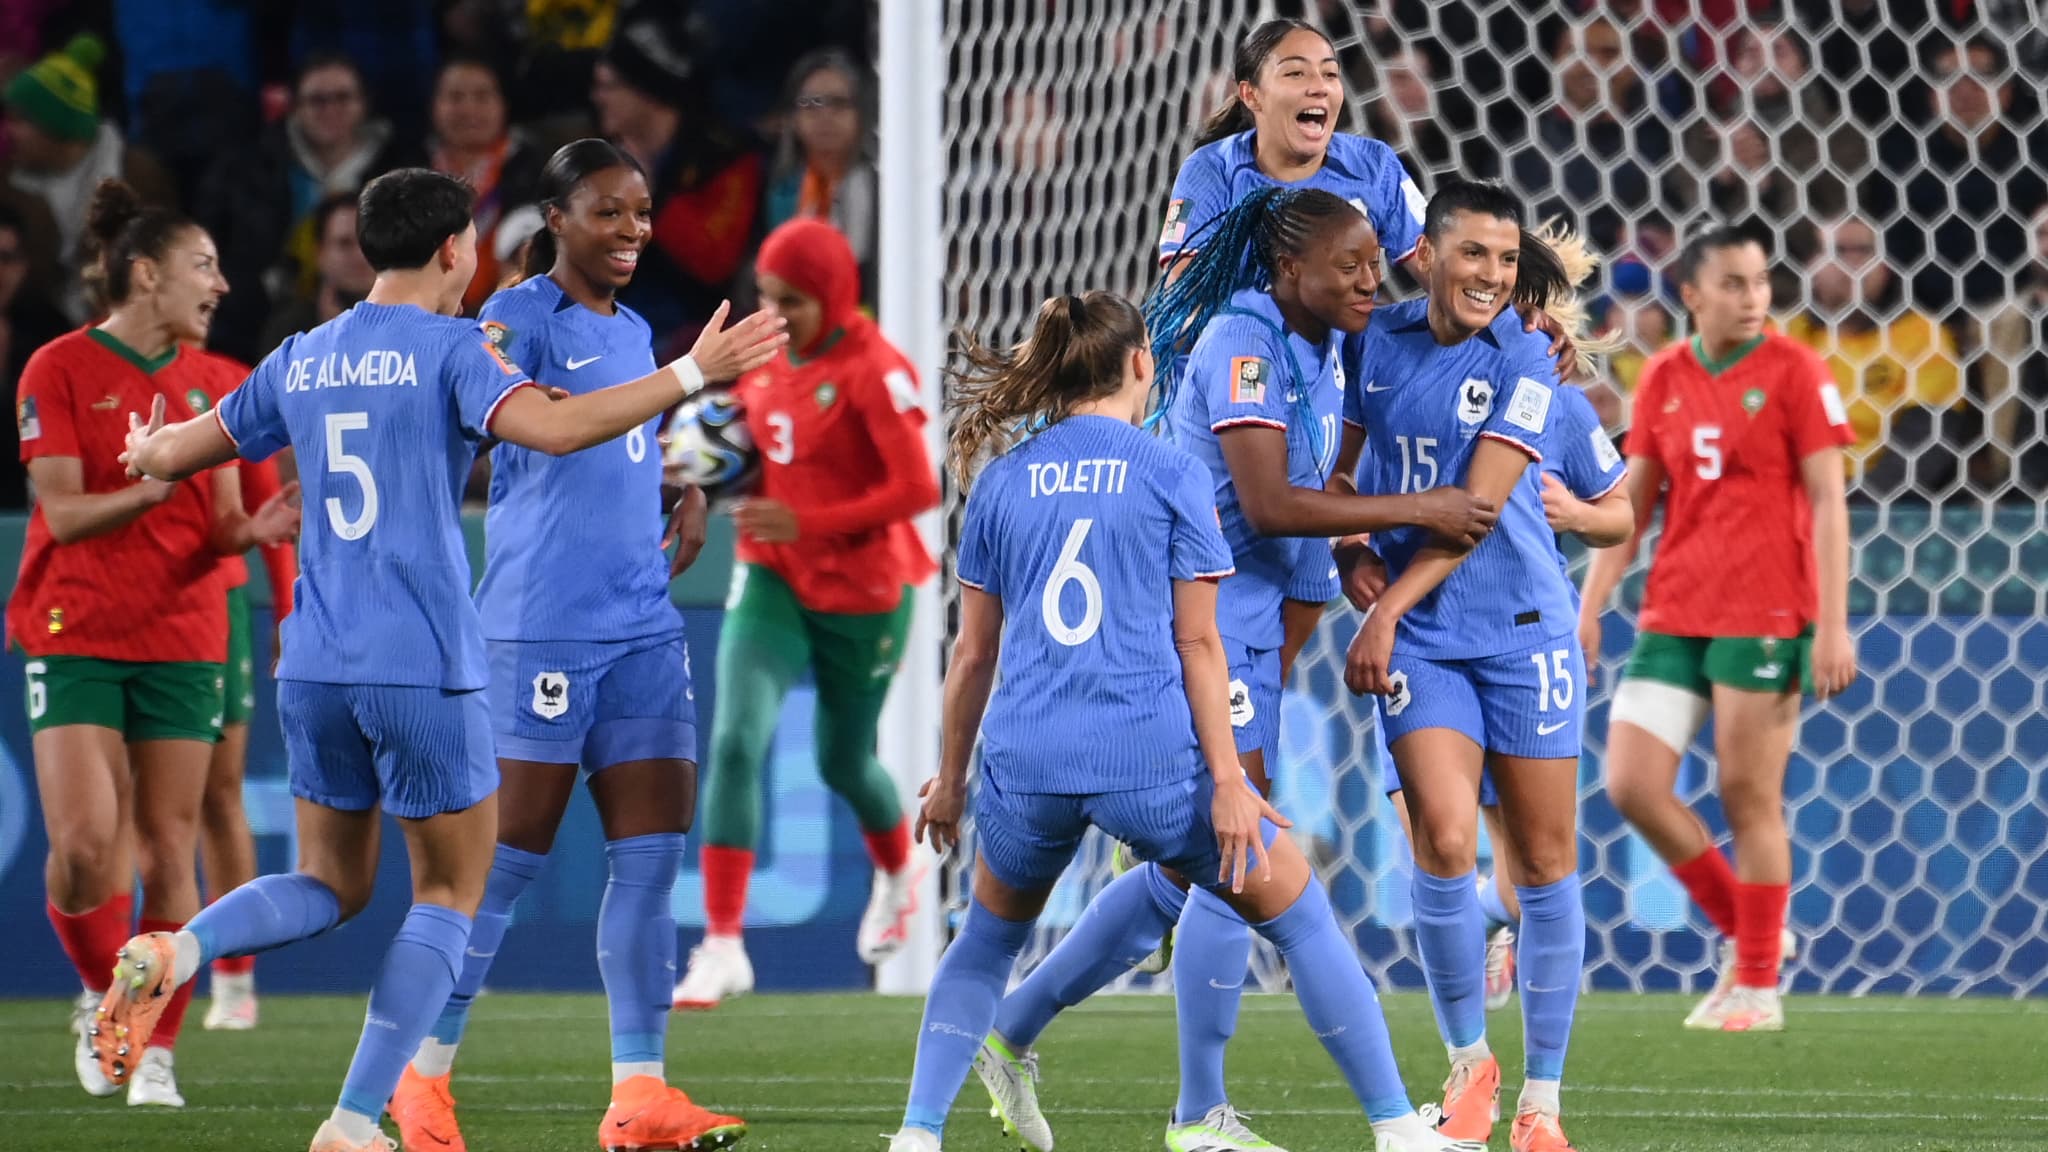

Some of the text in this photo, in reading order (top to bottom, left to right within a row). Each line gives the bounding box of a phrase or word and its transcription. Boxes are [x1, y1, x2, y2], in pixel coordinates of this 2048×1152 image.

[286, 350, 418, 393] DE ALMEIDA
[767, 413, 793, 465] 3
[1396, 435, 1438, 494] 15
[1693, 427, 1722, 480] 5
[325, 412, 378, 541] 5
[1028, 459, 1128, 498] TOLETTI
[1042, 518, 1103, 646] 6
[25, 661, 48, 720] 6
[1532, 649, 1583, 712] 15
